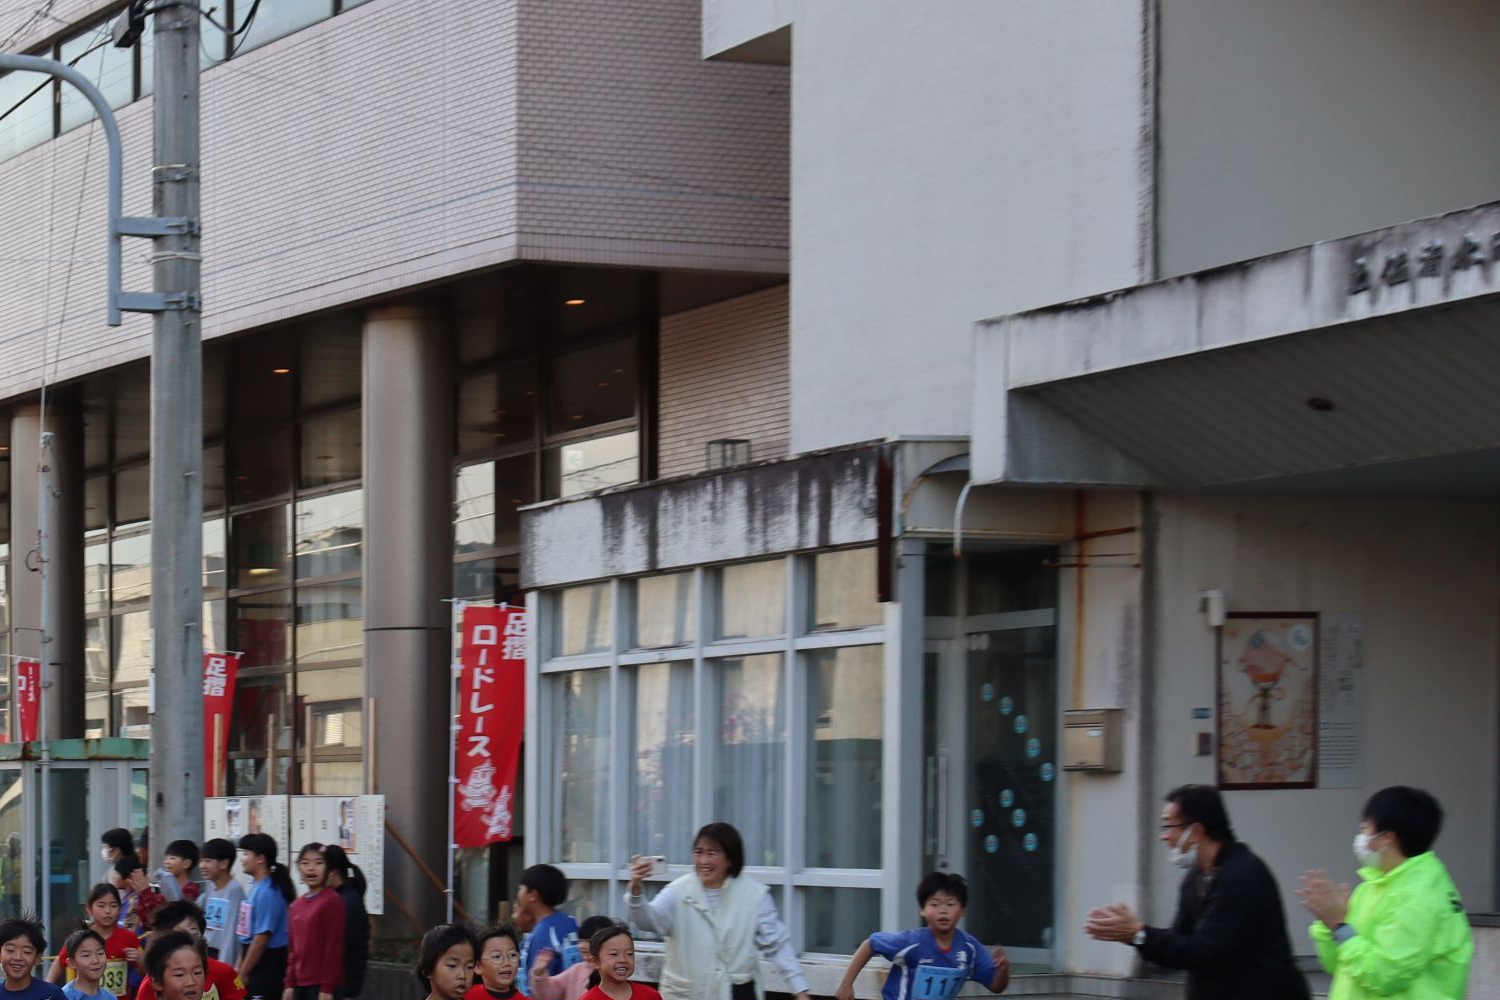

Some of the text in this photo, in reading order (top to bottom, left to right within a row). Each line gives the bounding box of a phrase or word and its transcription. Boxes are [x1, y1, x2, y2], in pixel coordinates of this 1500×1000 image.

[203, 657, 228, 697] 足摺
[467, 624, 497, 758] ロードレース
[100, 971, 124, 989] 033
